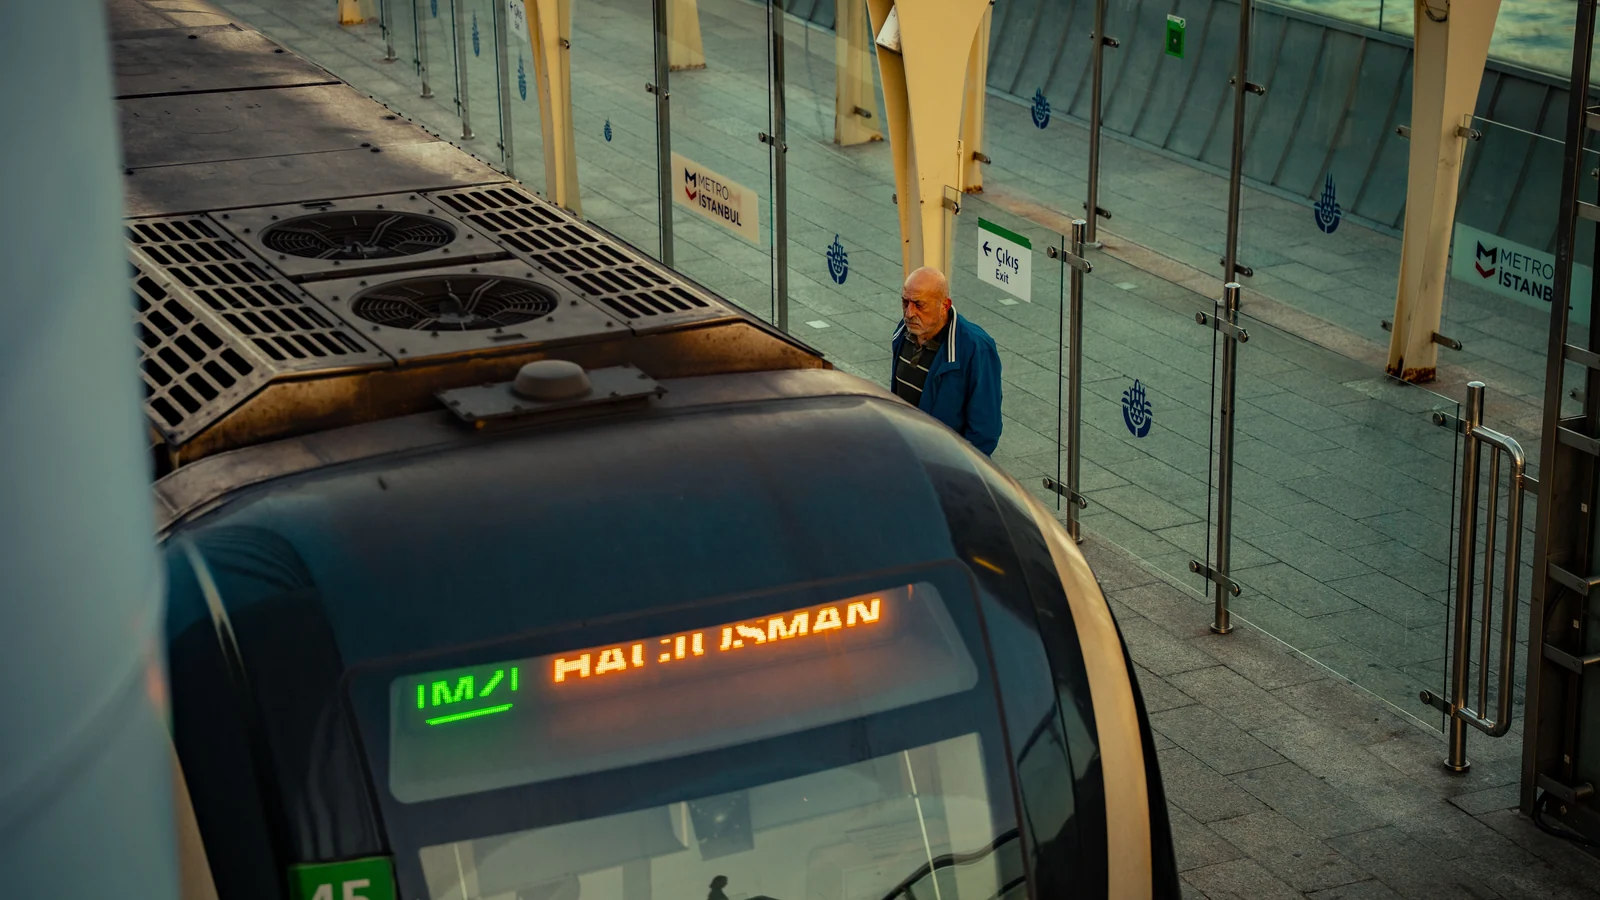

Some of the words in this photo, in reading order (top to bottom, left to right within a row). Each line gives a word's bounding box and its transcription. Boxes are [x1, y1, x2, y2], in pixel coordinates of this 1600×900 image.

[698, 172, 729, 201] METRO
[698, 189, 742, 227] İSTANBUL
[996, 247, 1019, 275] Çıkış
[1500, 248, 1554, 280] METRO
[995, 268, 1010, 285] Exit
[1498, 267, 1573, 311] İSTANB
